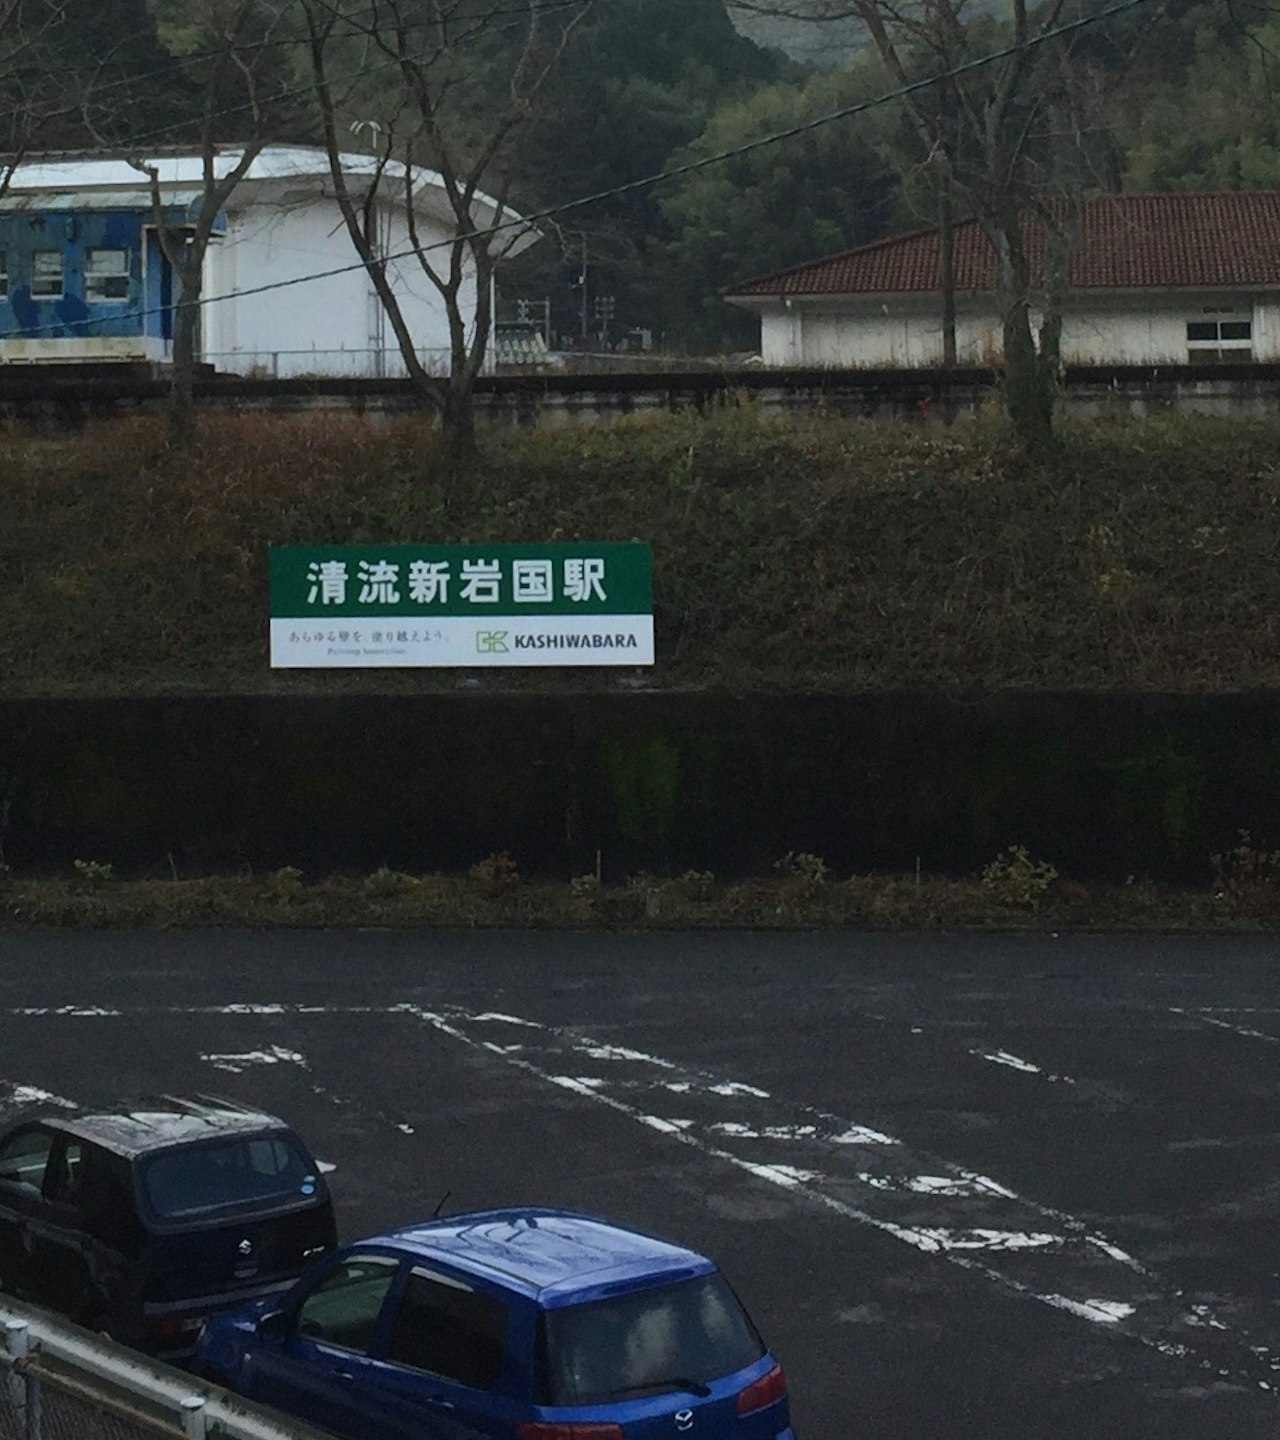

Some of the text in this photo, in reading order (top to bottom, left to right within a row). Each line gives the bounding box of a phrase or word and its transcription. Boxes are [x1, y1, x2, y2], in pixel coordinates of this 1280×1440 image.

[306, 558, 608, 605] 清流新岩国駅
[515, 634, 638, 649] KASHIWABARA
